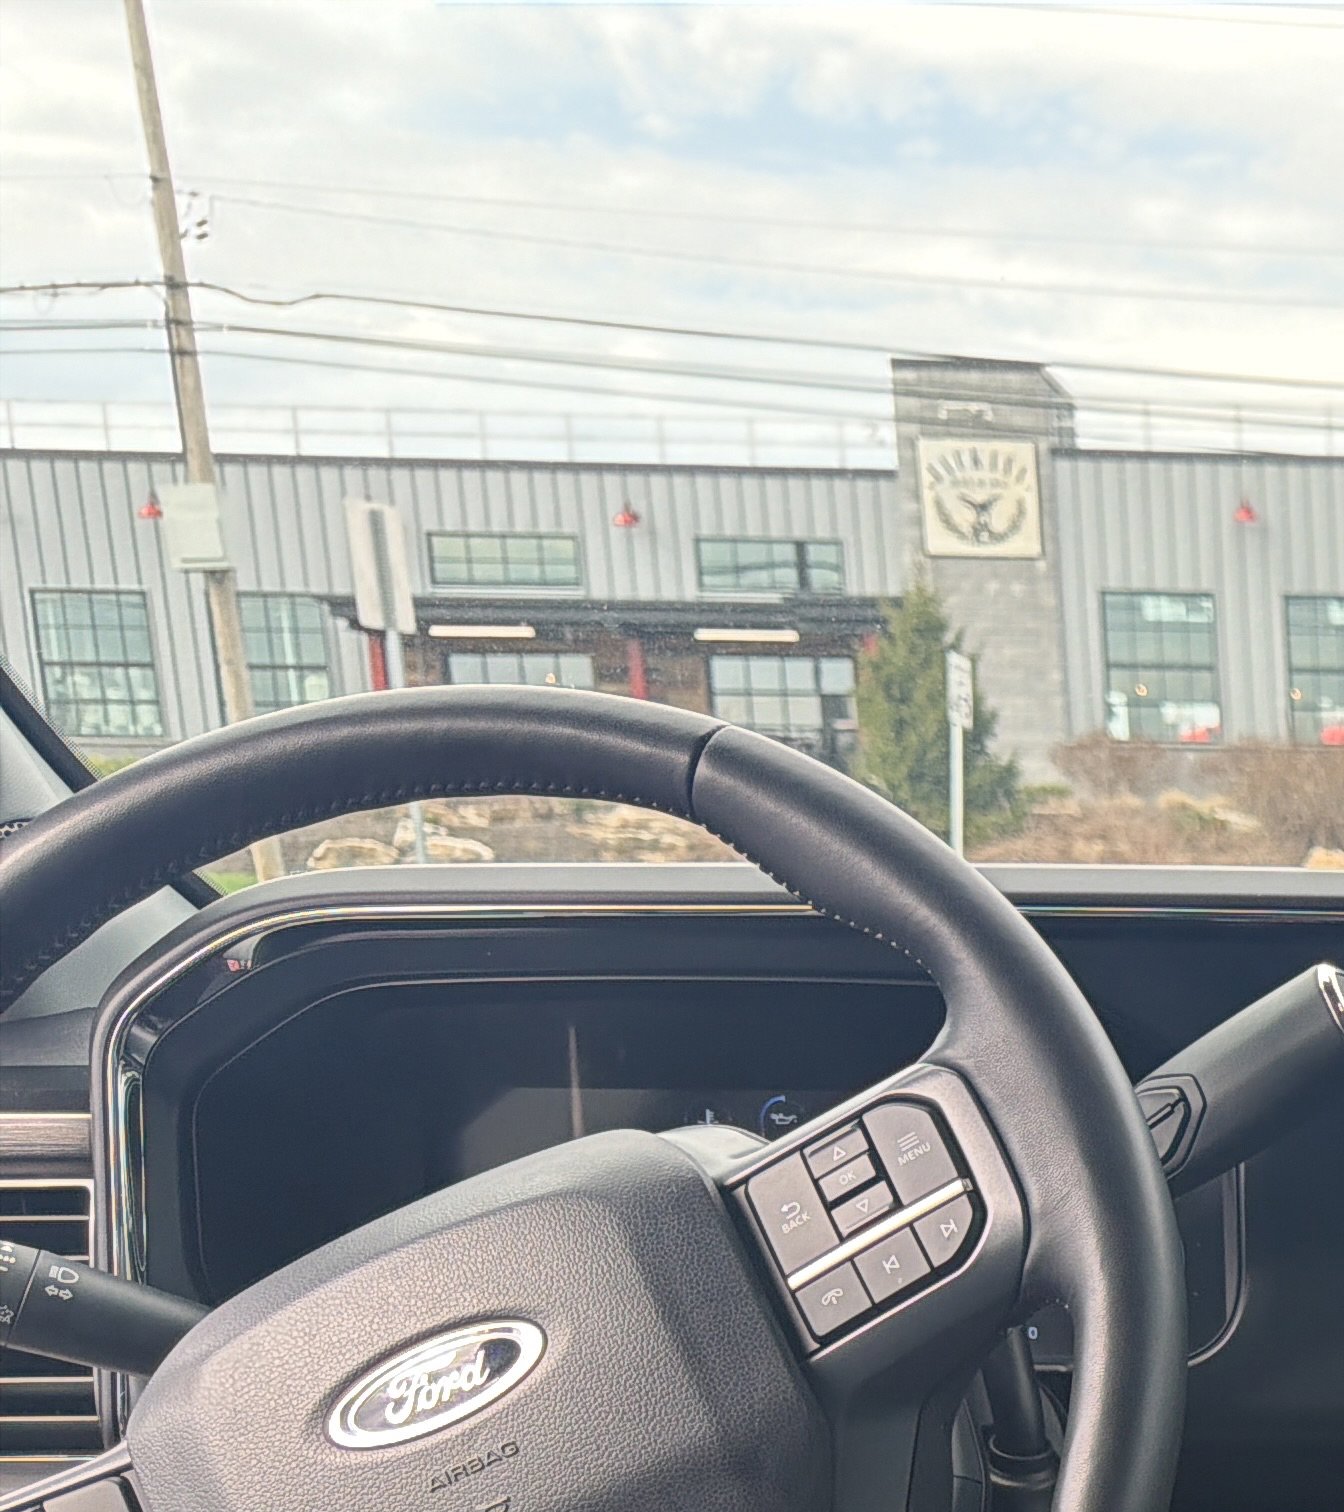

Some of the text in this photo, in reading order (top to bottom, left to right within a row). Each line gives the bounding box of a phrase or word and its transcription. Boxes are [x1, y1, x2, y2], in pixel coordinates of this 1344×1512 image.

[897, 1142, 932, 1167] MENU
[838, 1170, 857, 1187] OK
[780, 1212, 811, 1234] BACK
[429, 1440, 521, 1494] AIRBAG
